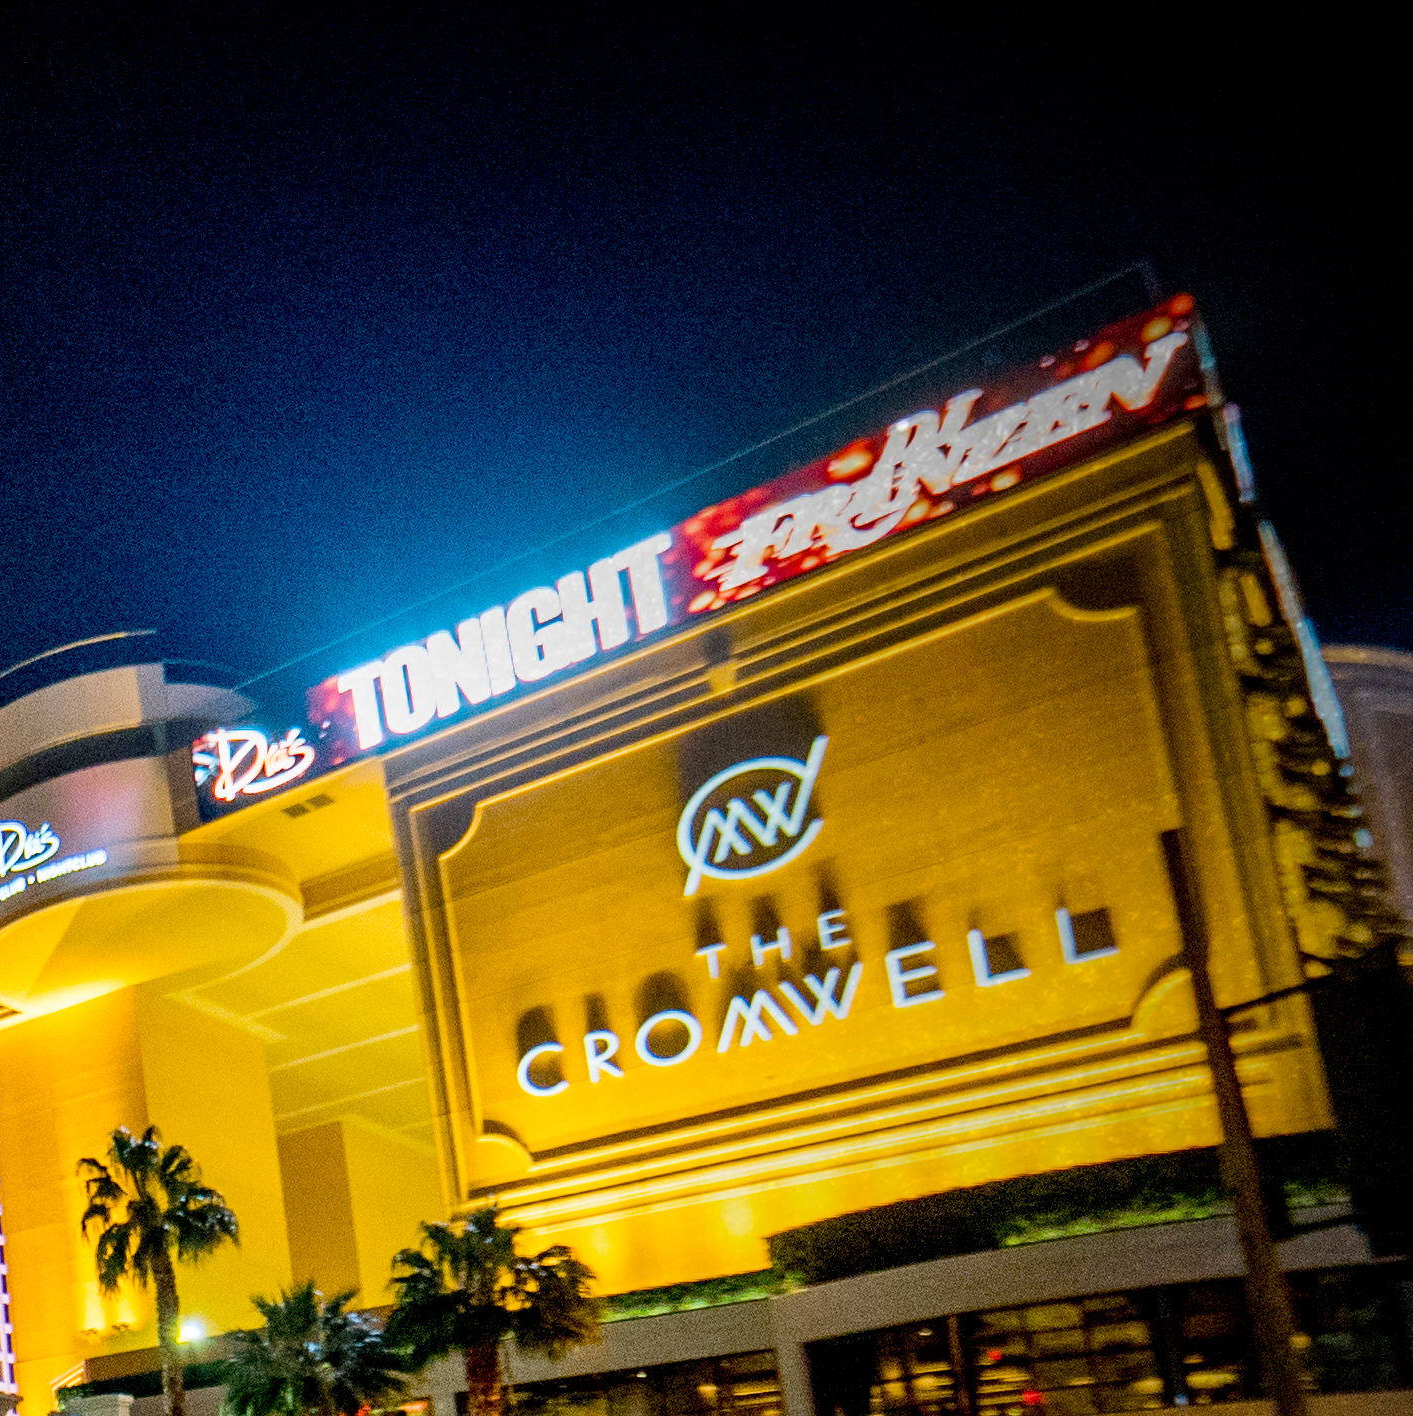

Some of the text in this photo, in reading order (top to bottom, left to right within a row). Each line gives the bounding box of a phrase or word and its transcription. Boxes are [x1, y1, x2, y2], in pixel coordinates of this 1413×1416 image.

[336, 532, 672, 752] TONIGHT
[515, 905, 1119, 1098] CROMWELL
[693, 907, 854, 982] THE
